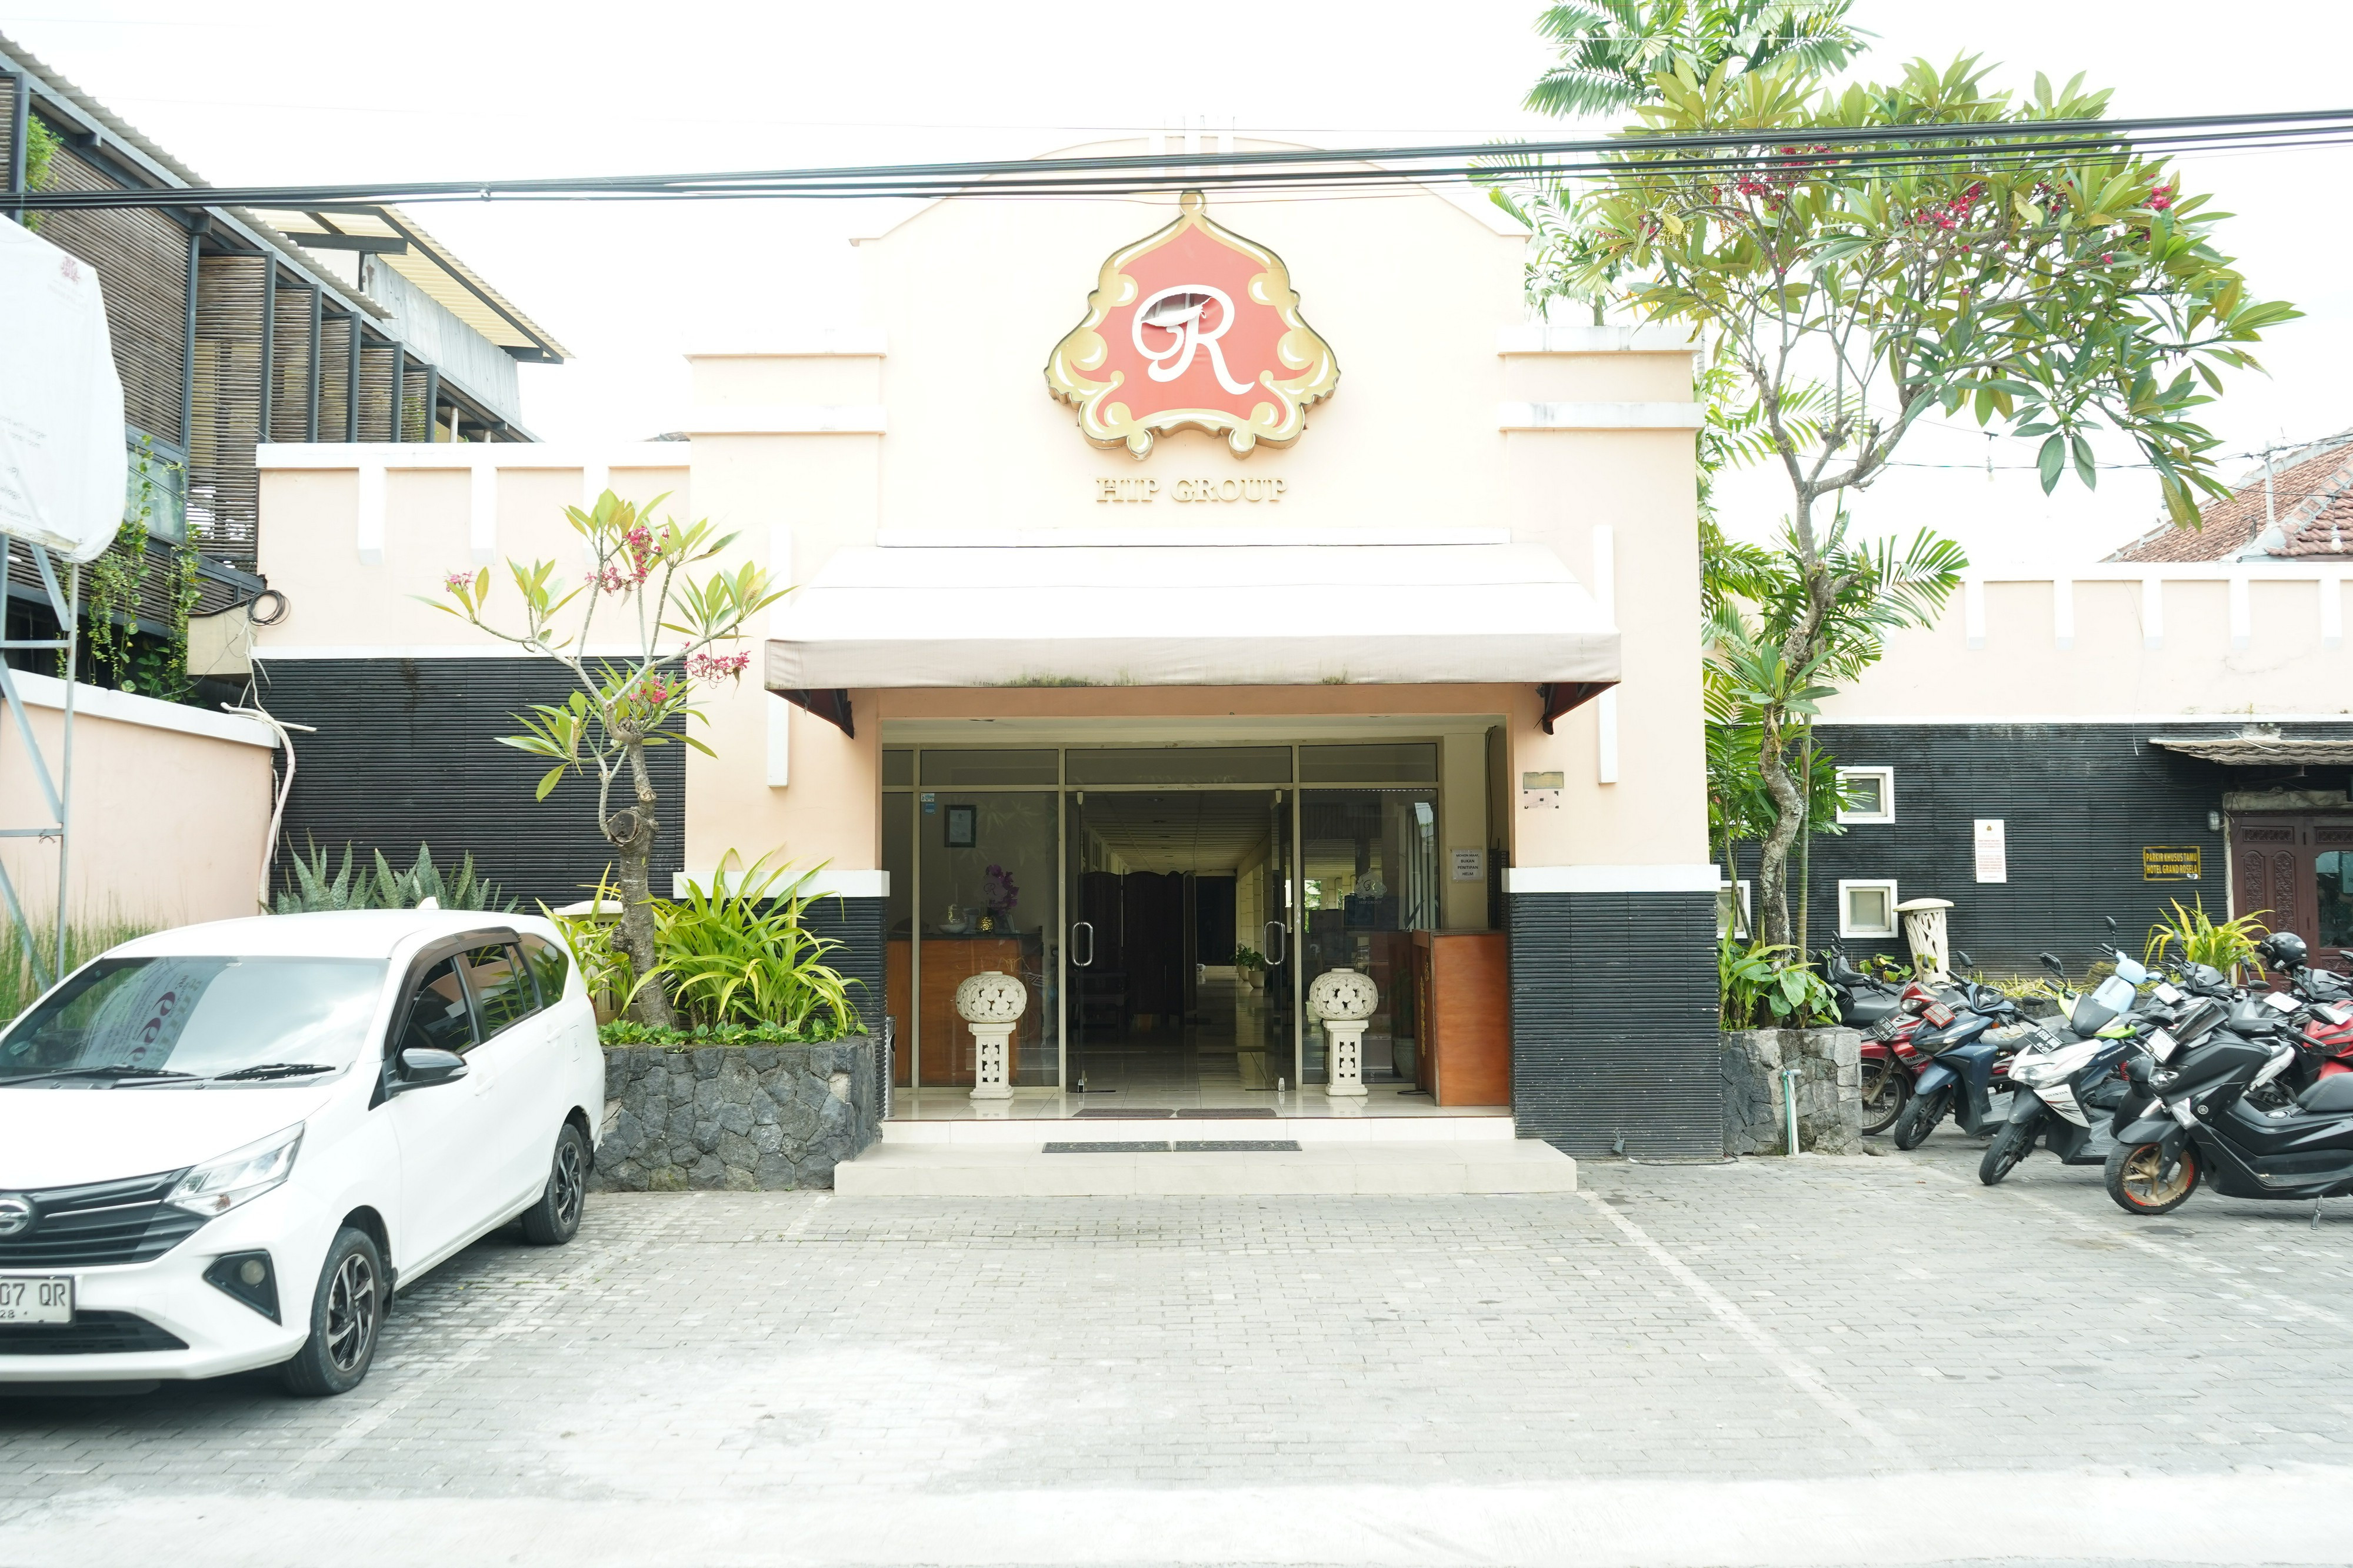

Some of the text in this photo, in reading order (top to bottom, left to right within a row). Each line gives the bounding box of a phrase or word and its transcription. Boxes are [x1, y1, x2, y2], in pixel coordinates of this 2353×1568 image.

[1096, 478, 1288, 502] HIP GROUP
[2146, 853, 2197, 862] PARKIR KHUSUS TAMU
[2147, 865, 2197, 873] HOTEL GRAND ROSELA
[1973, 1047, 1992, 1056] HONDA
[1905, 1053, 1926, 1063] YAMAHA
[0, 1283, 66, 1306] 07 QR
